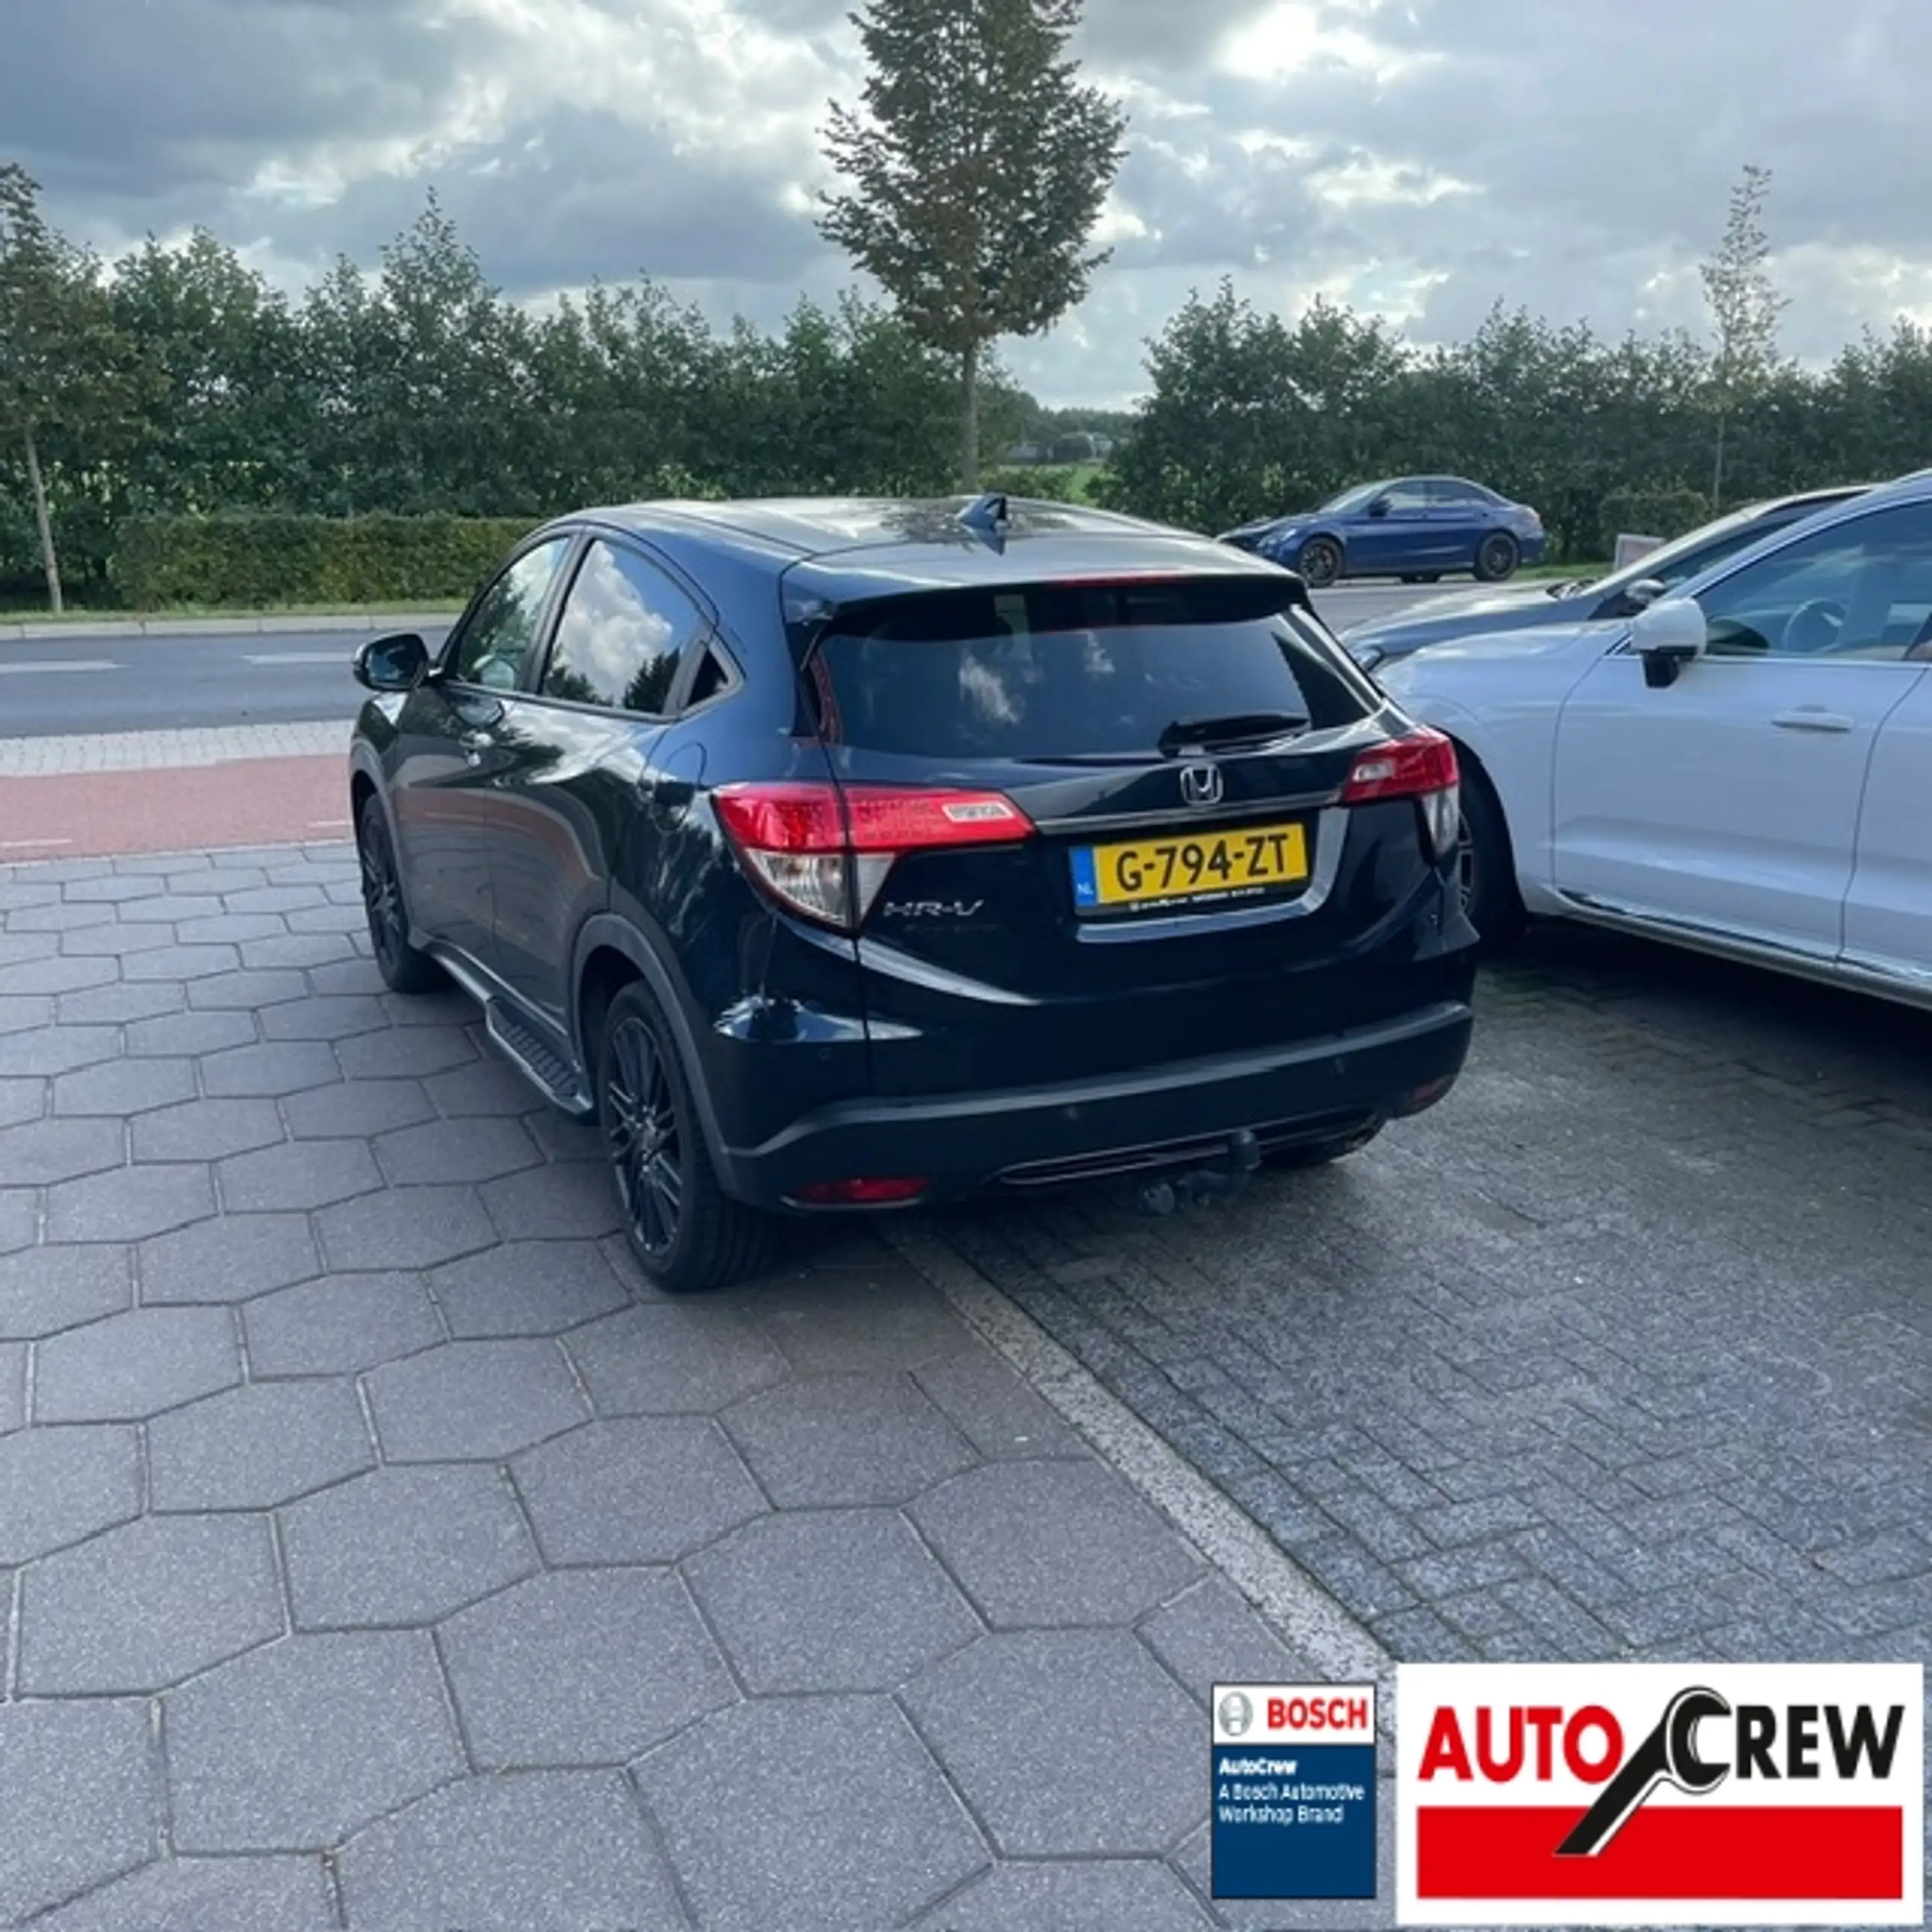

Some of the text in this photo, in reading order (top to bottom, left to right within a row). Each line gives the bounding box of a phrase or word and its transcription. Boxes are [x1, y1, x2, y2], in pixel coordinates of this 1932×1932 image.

[1116, 833, 1289, 892] G-794-ZT
[1077, 882, 1093, 896] NL
[883, 899, 985, 916] HR-V
